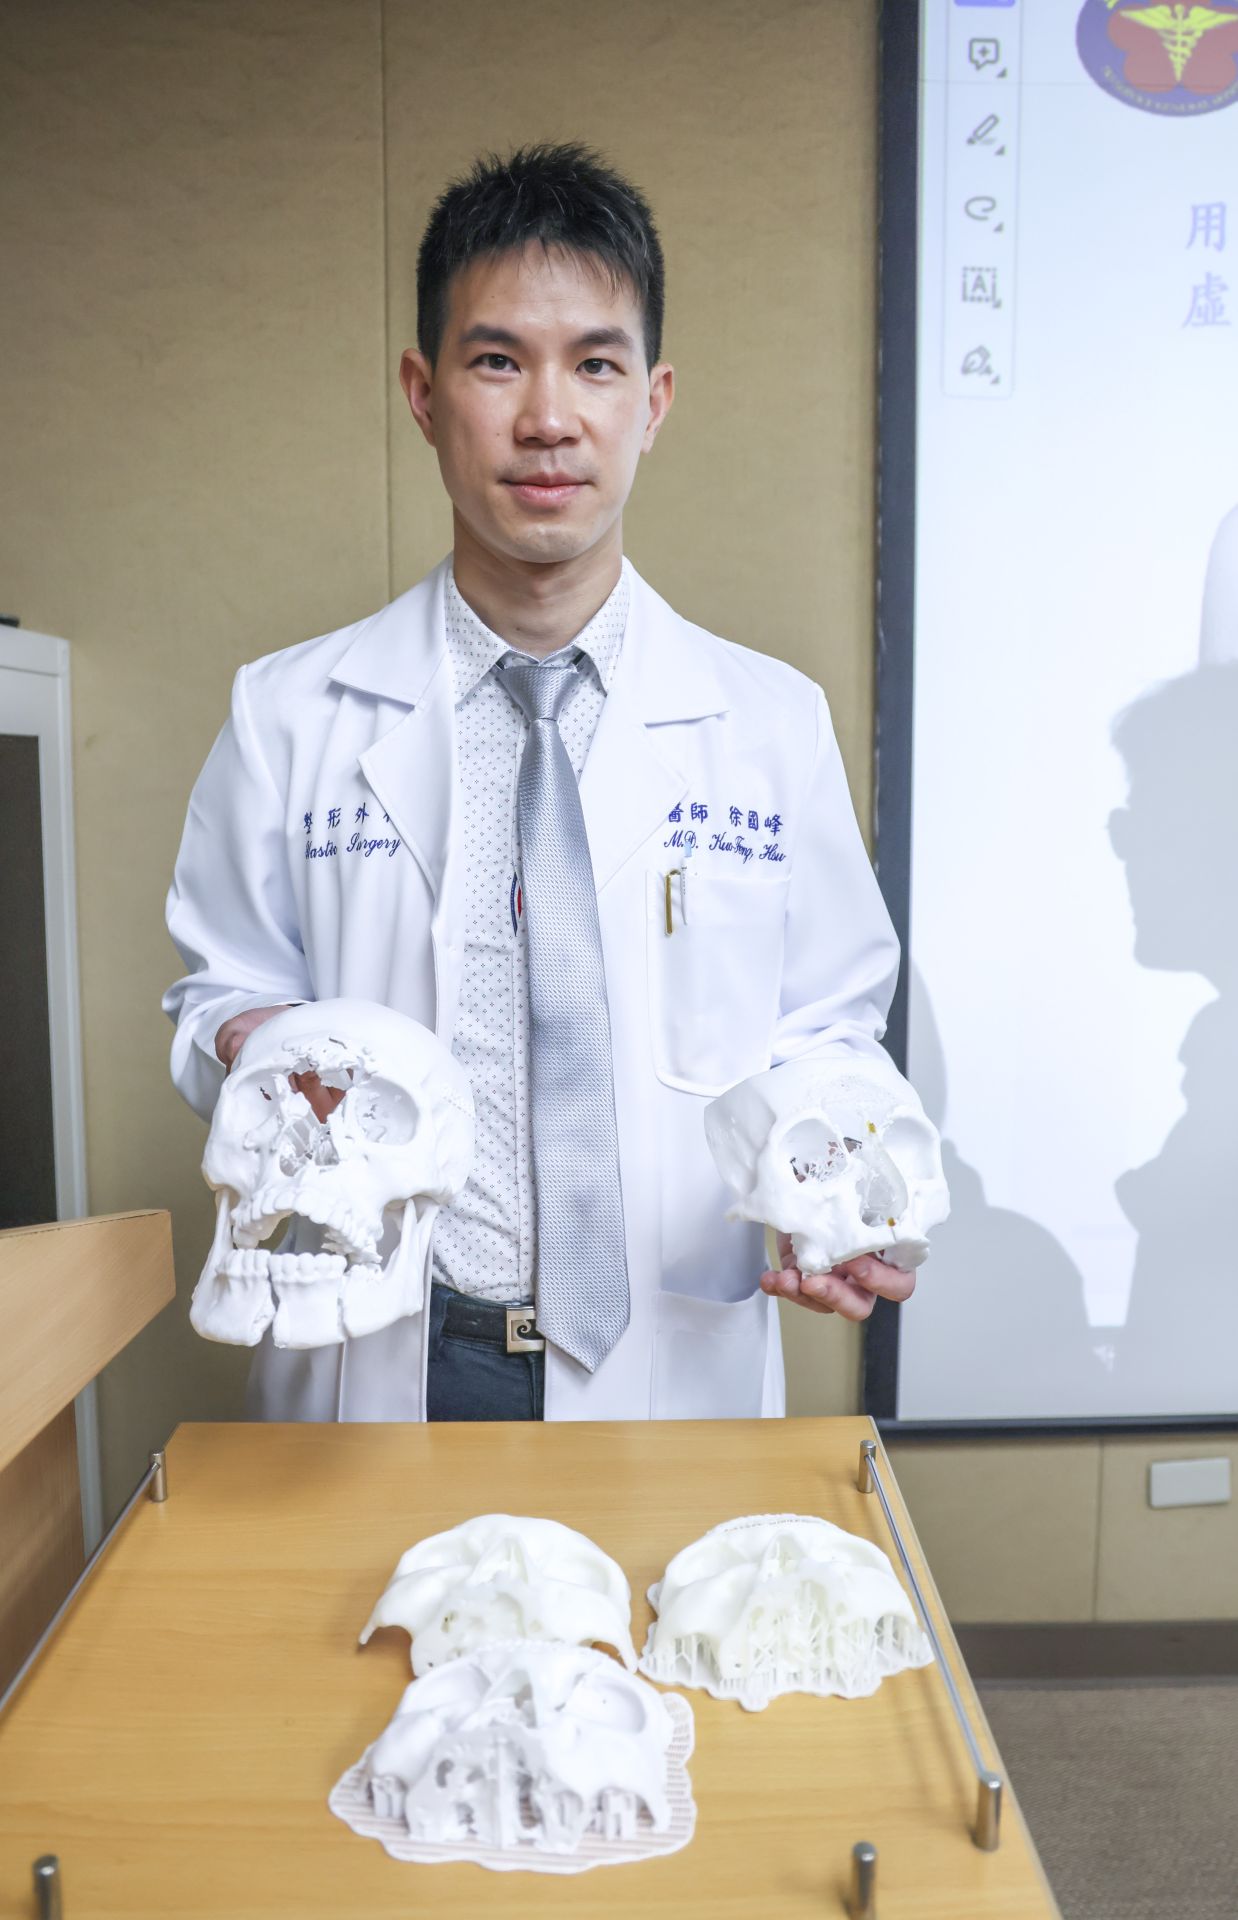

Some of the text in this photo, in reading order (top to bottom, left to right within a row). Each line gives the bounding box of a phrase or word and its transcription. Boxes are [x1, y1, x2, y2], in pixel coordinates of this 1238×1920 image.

[1186, 201, 1228, 253] 用
[729, 805, 783, 836] 徐國峰
